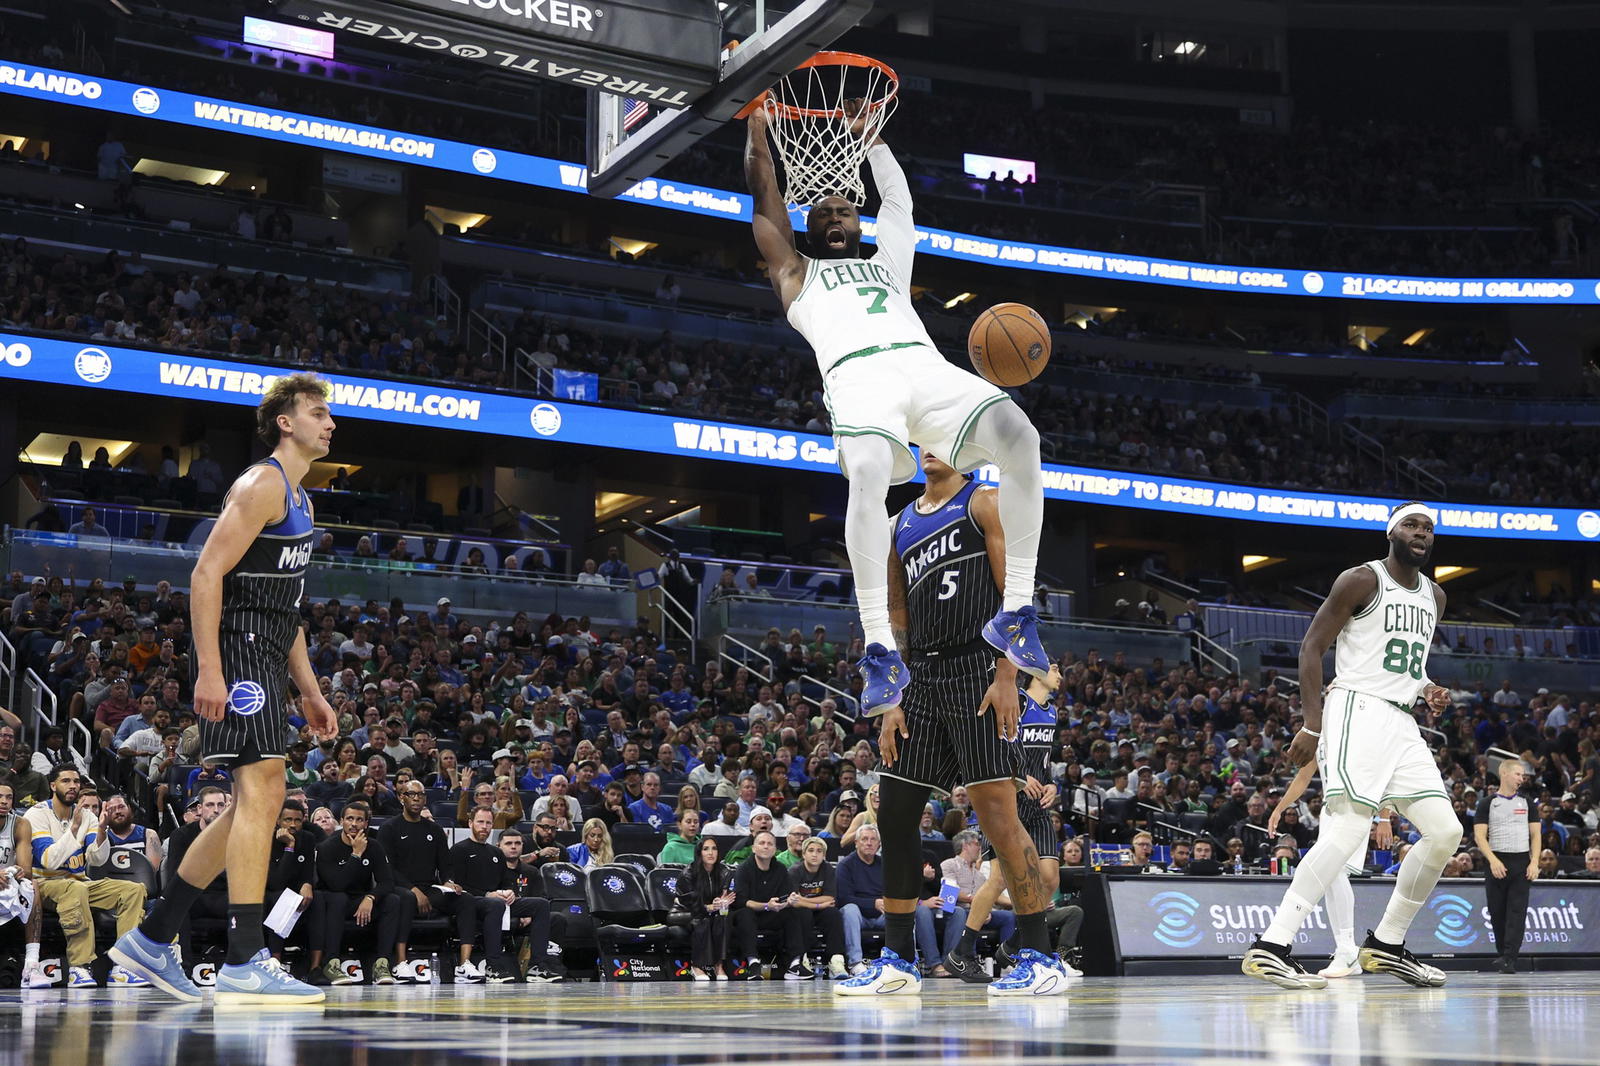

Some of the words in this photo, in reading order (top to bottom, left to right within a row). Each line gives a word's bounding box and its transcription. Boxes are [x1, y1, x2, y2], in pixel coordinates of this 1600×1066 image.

[194, 101, 435, 159] WATERSCARWASH.COM
[930, 233, 953, 249] TO
[999, 246, 1036, 262] AND
[1037, 250, 1103, 271] RECEIVE
[1105, 257, 1148, 276] YOUR
[1150, 263, 1189, 280] FREE
[1190, 267, 1238, 285] WASH
[820, 262, 901, 296] CELTICS
[1365, 278, 1461, 297] LOCATIONS
[1462, 282, 1484, 297] IN
[1485, 282, 1574, 298] ORLANDO
[856, 286, 889, 314] 7
[673, 421, 798, 461] WATERS
[1131, 480, 1159, 501] TO
[1215, 490, 1256, 511] AND
[1257, 495, 1335, 518] RECEIVE
[1337, 501, 1390, 522] YOUR
[1440, 508, 1498, 529] WASH
[937, 570, 960, 600] 5
[1384, 603, 1434, 641] CELTICS
[1382, 637, 1425, 681] 88
[1209, 903, 1328, 930] sumit
[629, 958, 644, 967] City
